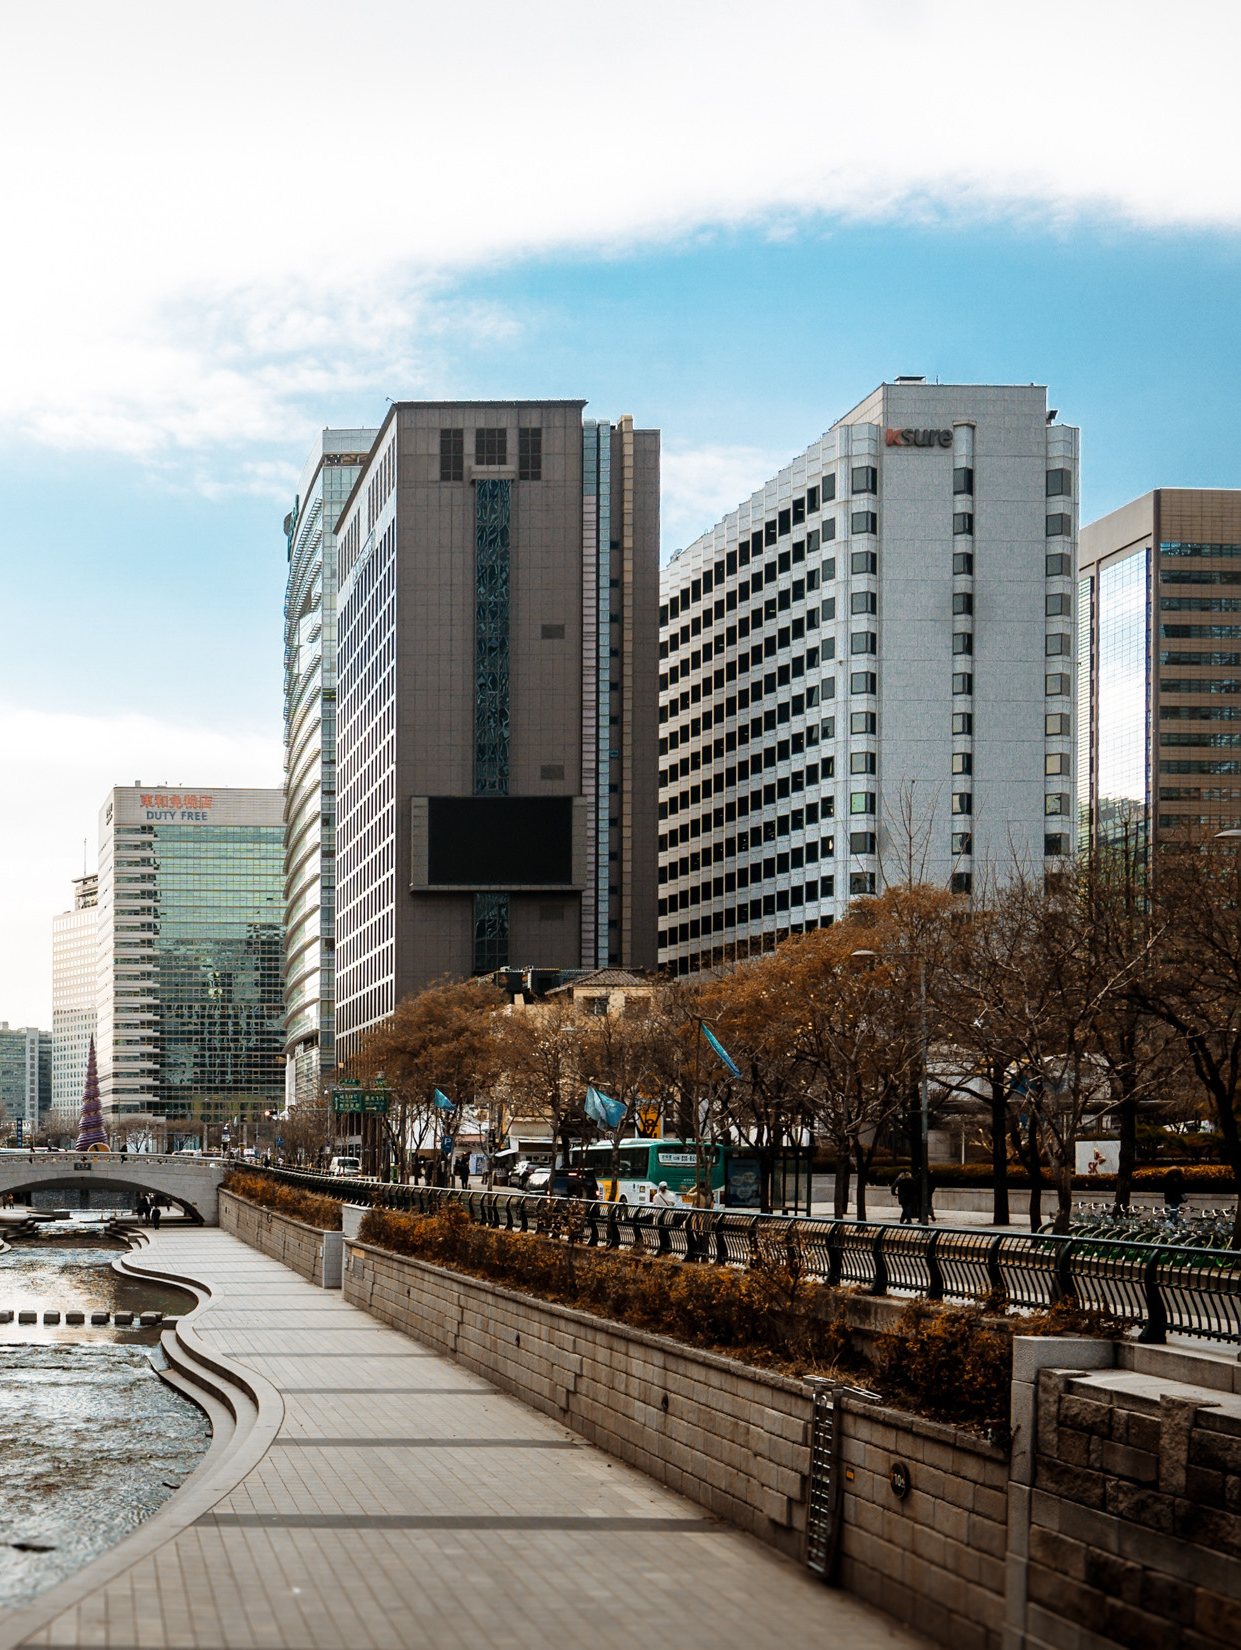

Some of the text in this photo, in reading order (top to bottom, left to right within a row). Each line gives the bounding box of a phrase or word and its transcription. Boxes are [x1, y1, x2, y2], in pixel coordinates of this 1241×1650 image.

[146, 811, 207, 820] DUTY FREE
[1088, 1162, 1098, 1174] SK
